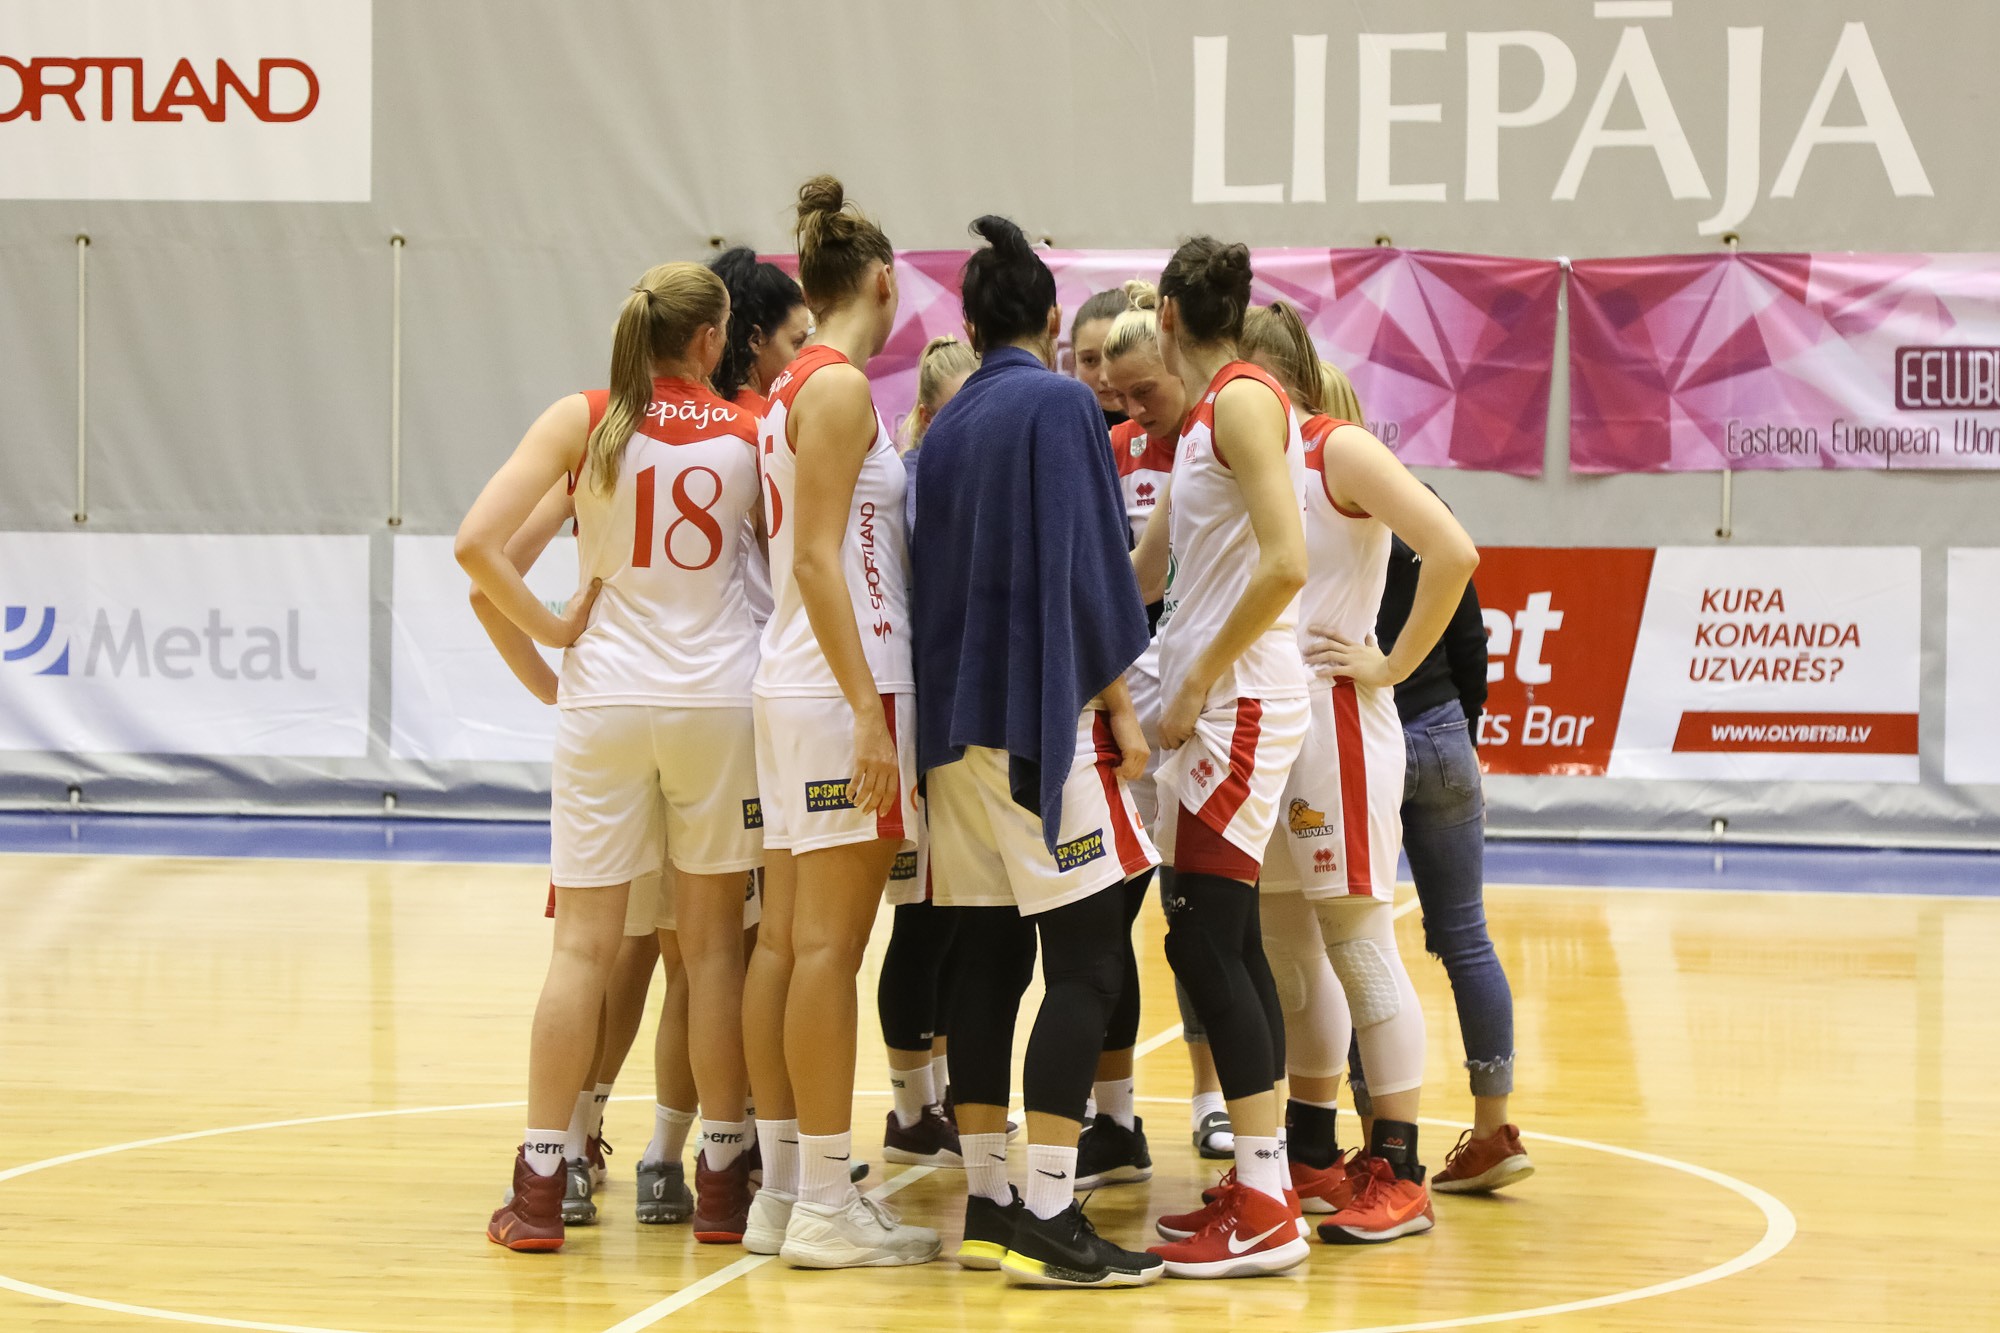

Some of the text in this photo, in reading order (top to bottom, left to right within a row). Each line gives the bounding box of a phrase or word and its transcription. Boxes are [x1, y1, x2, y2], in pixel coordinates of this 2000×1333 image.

[1192, 1, 1935, 236] LIEPĀJA
[644, 400, 738, 430] epāja
[1727, 419, 1818, 455] Eastern
[1832, 418, 1940, 470] European
[631, 465, 723, 571] 18
[860, 501, 886, 611] SPORTLAND
[1700, 587, 1785, 613] KURA
[83, 607, 317, 682] Metal
[1480, 591, 1564, 685] et
[1694, 623, 1861, 648] KOMANDA
[1688, 652, 1845, 683] UZVARĒS?
[1477, 704, 1595, 746] ts Bar
[1711, 724, 1872, 743] WWW.OLYBETSB.LV
[808, 784, 848, 799] SPORT
[1057, 835, 1101, 860] SPORTA
[1061, 847, 1101, 868] PUNKTS
[535, 1142, 565, 1154] erre
[711, 1132, 743, 1144] erre
